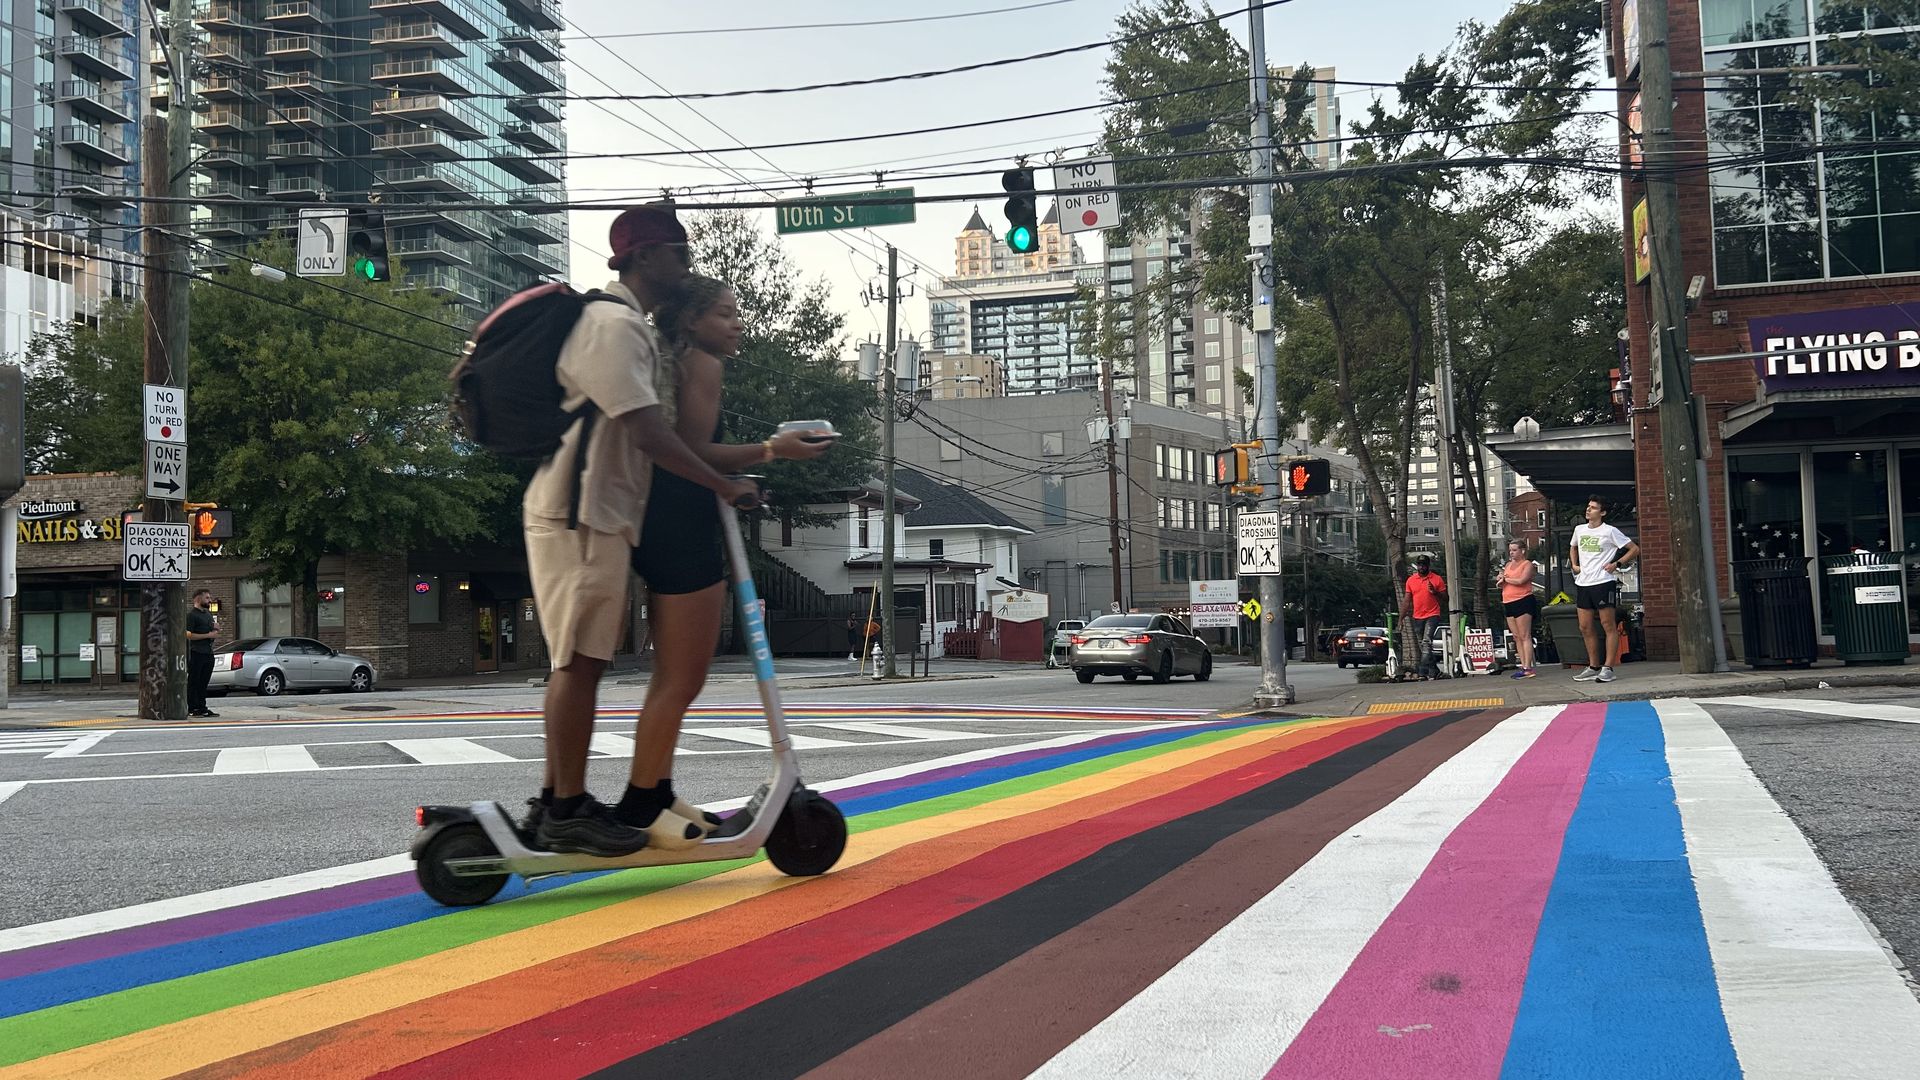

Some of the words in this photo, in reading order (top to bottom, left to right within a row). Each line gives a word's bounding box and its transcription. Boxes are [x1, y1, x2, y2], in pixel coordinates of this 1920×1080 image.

[1071, 163, 1096, 179] NO
[1065, 197, 1081, 209] ON
[1087, 192, 1110, 206] RED
[782, 204, 824, 228] 10th
[833, 204, 855, 224] St
[303, 257, 338, 270] ONLY
[1765, 331, 1888, 376] FLYING
[156, 391, 174, 403] NO
[154, 404, 178, 415] TURN
[149, 416, 162, 425] ON
[166, 417, 183, 427] RED
[155, 446, 181, 461] ONE
[153, 461, 181, 476] WAY
[20, 500, 76, 514] Piedmont
[1240, 517, 1277, 528] DIAGONAL
[18, 519, 78, 544] NAILS
[82, 519, 98, 539] &
[128, 526, 187, 537] DIAGONAL
[1240, 528, 1277, 538] CROSSING
[129, 537, 186, 546] CROSSING
[128, 553, 151, 571] OK
[1240, 546, 1256, 566] OK
[1466, 635, 1492, 645] VAPE
